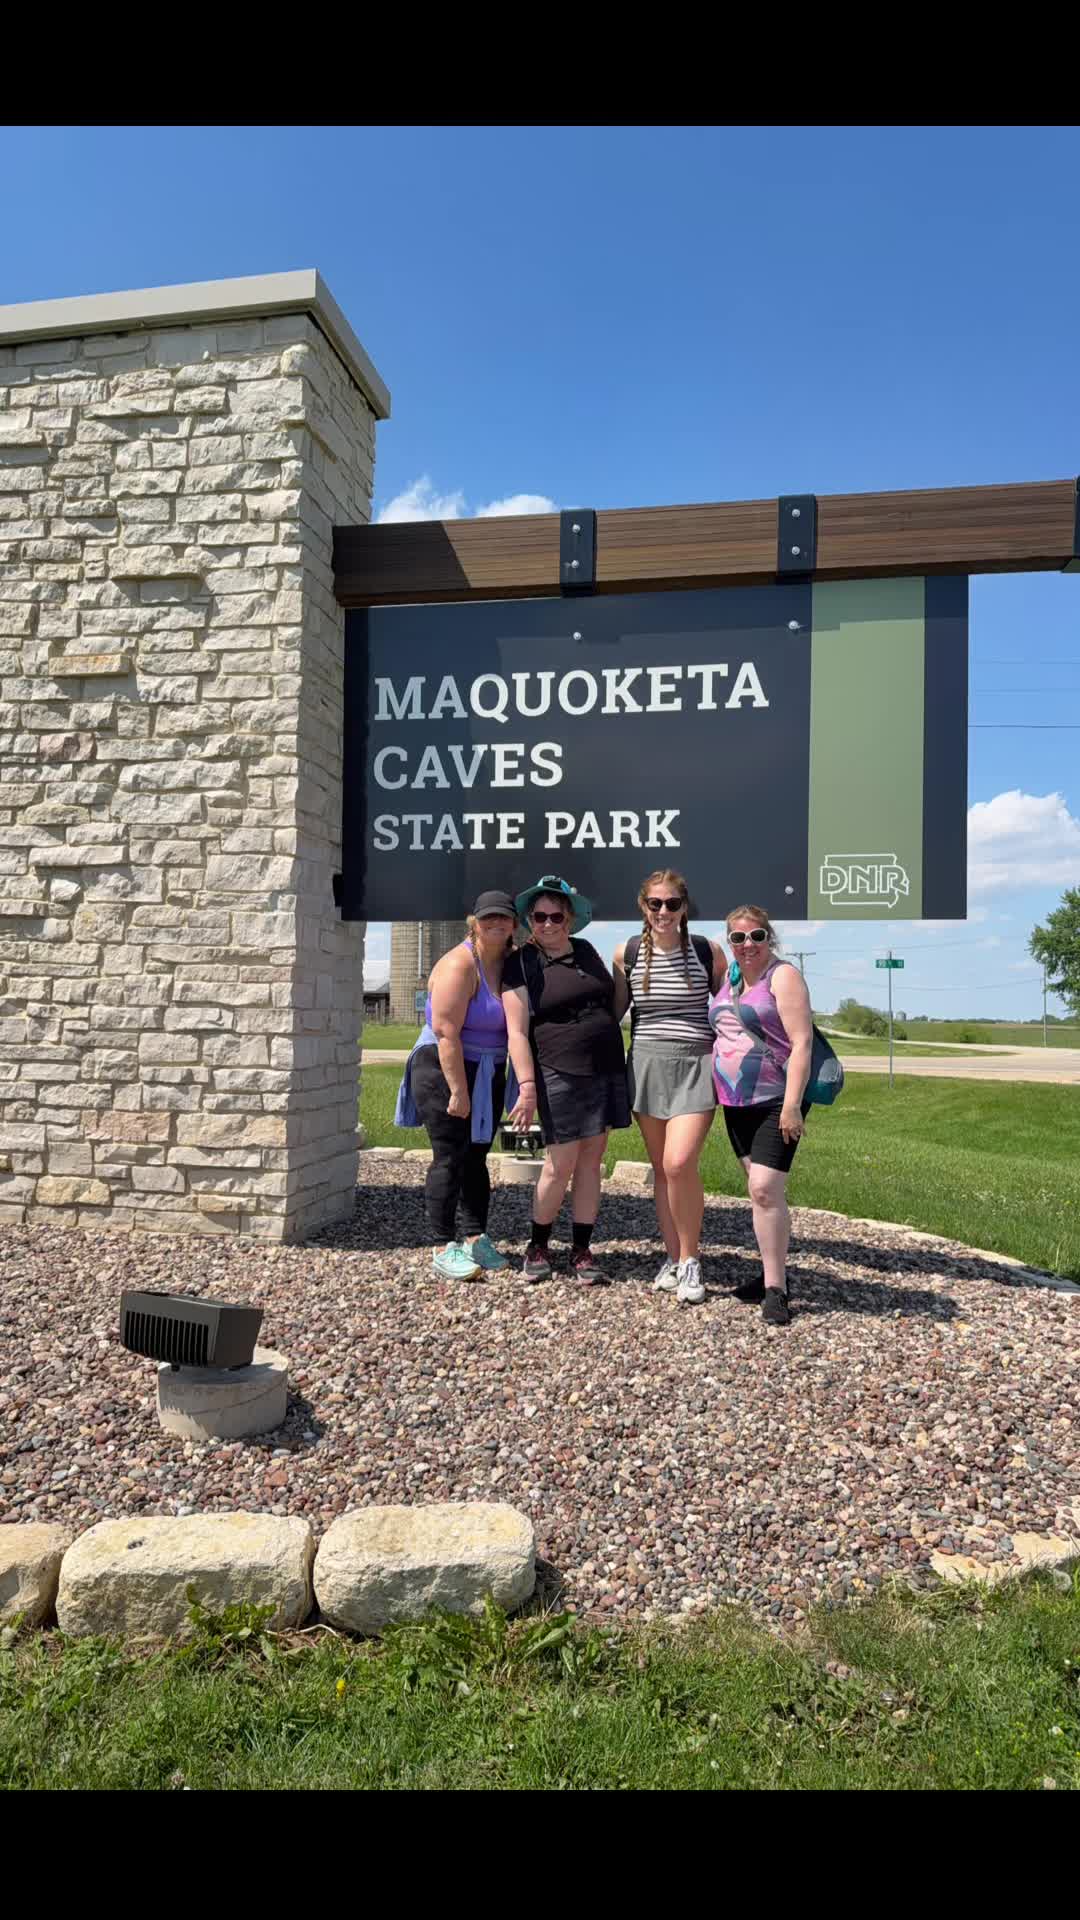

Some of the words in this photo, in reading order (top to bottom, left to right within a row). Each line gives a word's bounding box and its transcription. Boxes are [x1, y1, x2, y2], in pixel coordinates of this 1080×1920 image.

[374, 662, 769, 723] MAQUOKETA
[373, 742, 563, 789] CAVES
[373, 812, 525, 850] STATE
[544, 809, 681, 849] PARK
[820, 865, 909, 895] DNR
